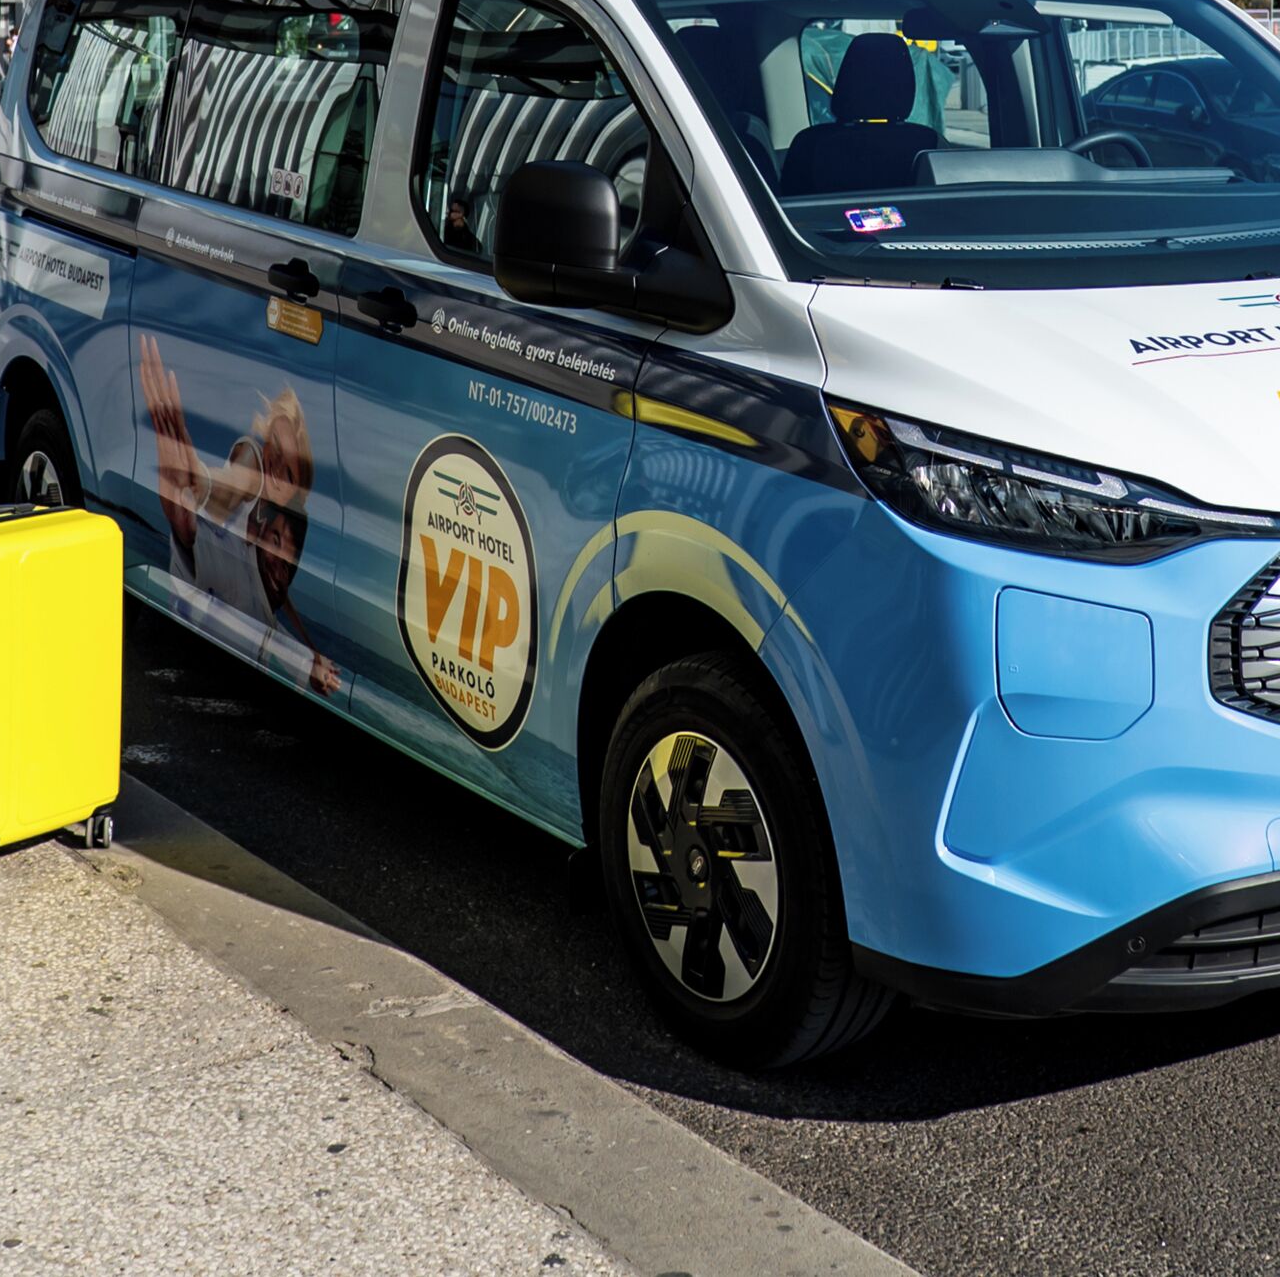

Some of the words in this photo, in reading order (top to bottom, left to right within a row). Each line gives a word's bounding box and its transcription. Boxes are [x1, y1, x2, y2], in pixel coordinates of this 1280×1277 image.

[19, 245, 47, 270] AIRPORT
[45, 255, 67, 279] HOTEL
[67, 263, 104, 292] BUDAPEST
[448, 317, 480, 340] Online
[481, 325, 523, 356] foglalás,
[525, 343, 556, 363] gyors
[557, 348, 616, 382] beléptetés
[1128, 327, 1269, 355] AIRPORT
[468, 380, 577, 434] NT-01-757/002473
[427, 510, 475, 547] AIRPORT
[478, 531, 514, 565] HOTEL
[419, 533, 520, 673] VIP
[431, 651, 496, 699] PARKOLÓ
[433, 672, 497, 722] BUDAPEST
